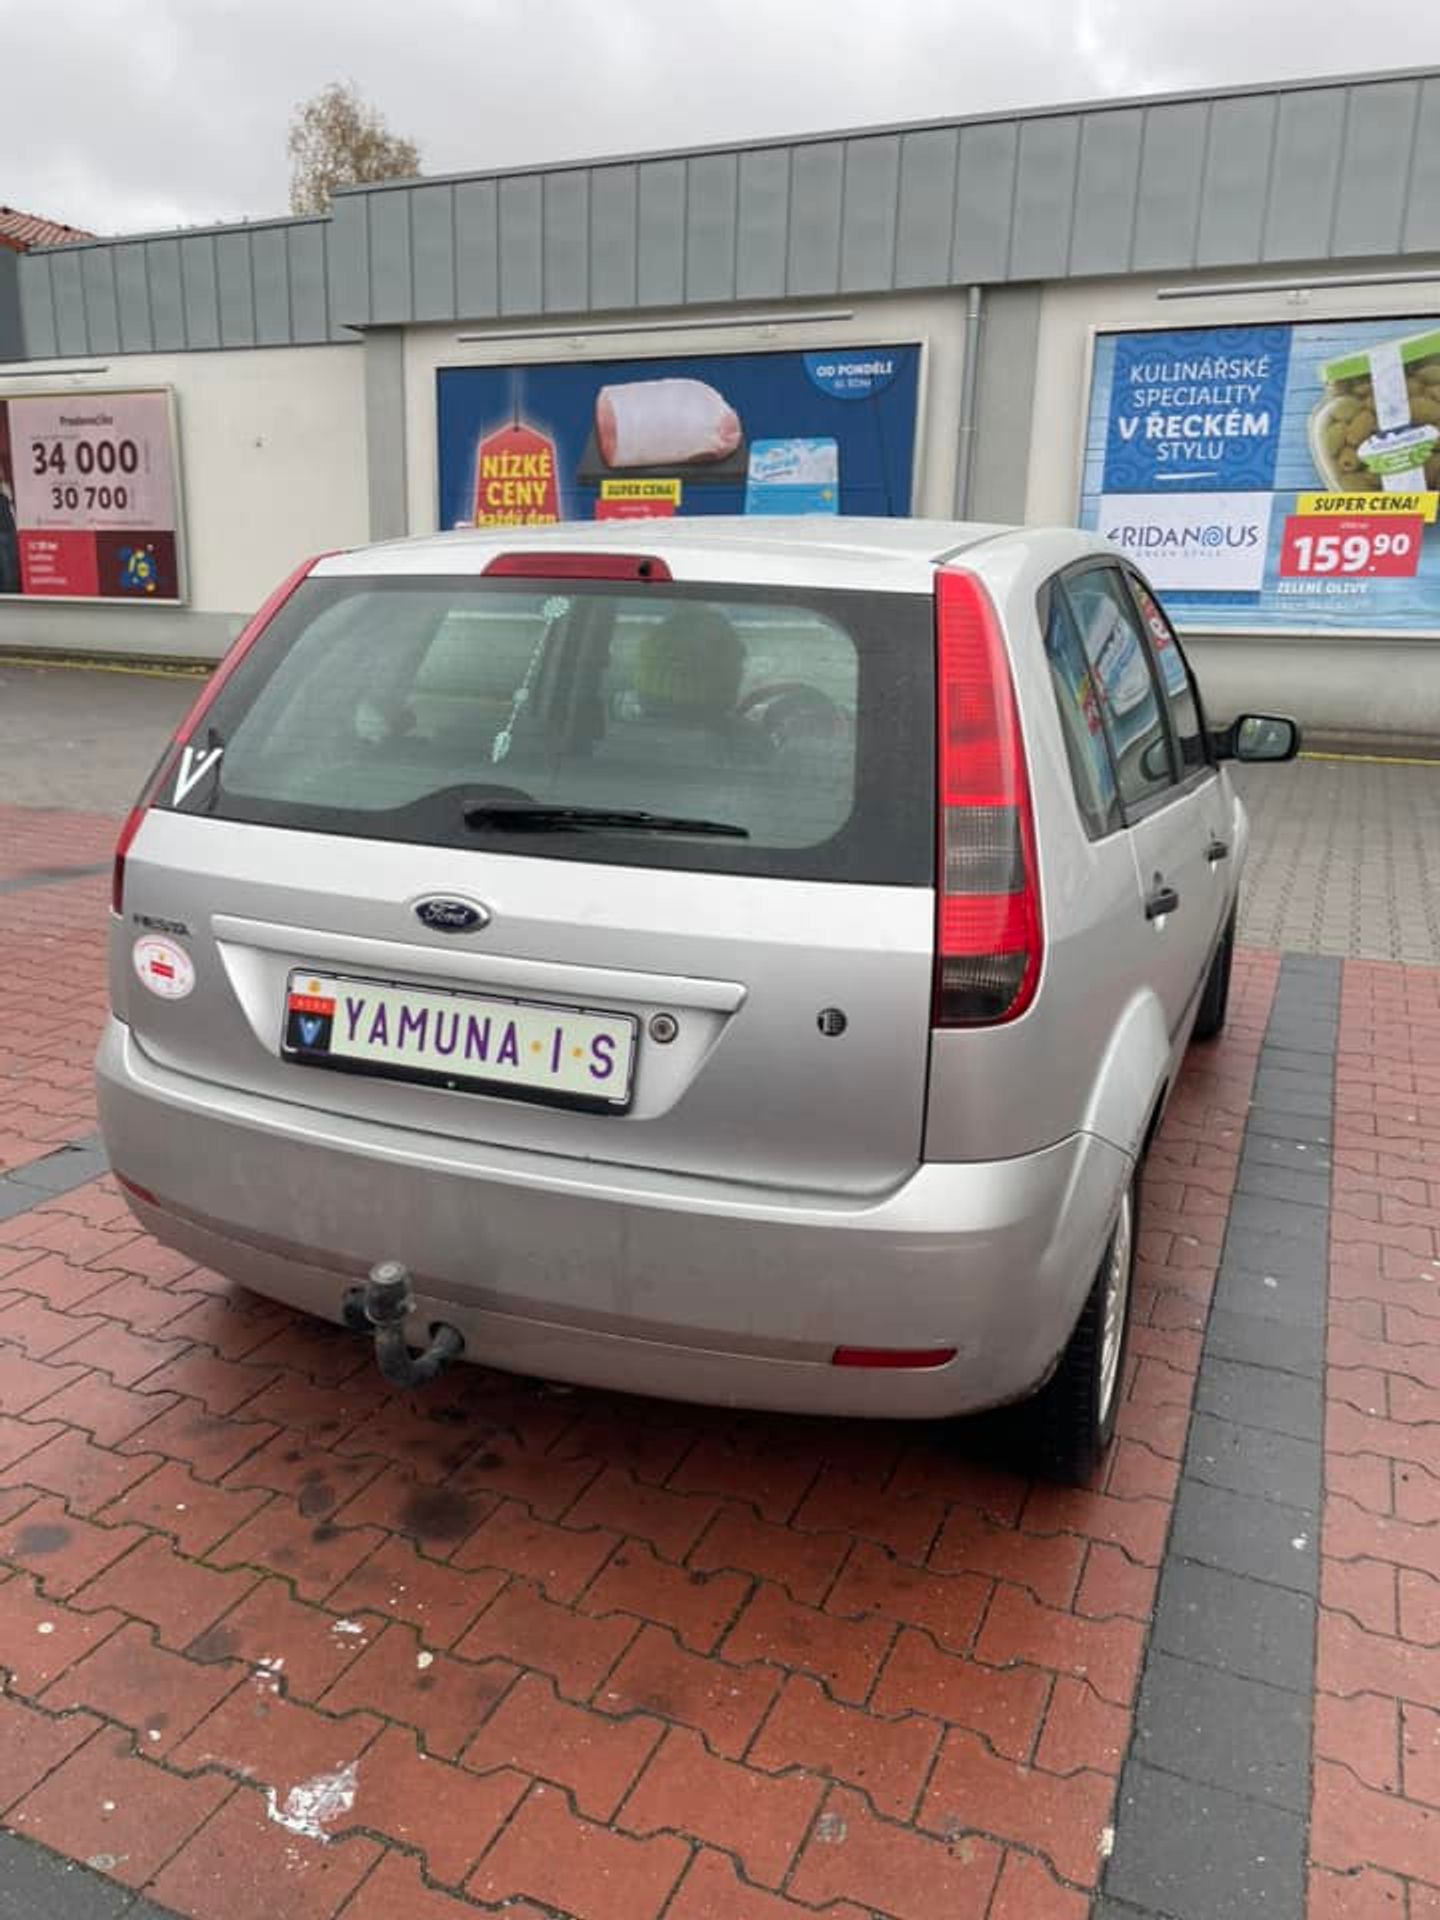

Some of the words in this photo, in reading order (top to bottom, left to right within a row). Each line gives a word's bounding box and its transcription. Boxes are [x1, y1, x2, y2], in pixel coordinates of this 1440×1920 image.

[816, 365, 835, 377] OD
[1130, 355, 1270, 384] KULINÁŘSKÉ
[1133, 385, 1262, 408] SPECIALITY
[1118, 417, 1140, 439] V
[1147, 411, 1270, 438] ŘECKÉM
[32, 442, 66, 475] 34
[76, 439, 138, 475] 000
[482, 448, 551, 478] NÍZKÉ
[1157, 441, 1223, 462] STYLU
[52, 486, 79, 510] 30
[84, 486, 127, 510] 700
[486, 479, 548, 506] CENY
[607, 483, 637, 497] SUPER
[1314, 497, 1367, 512] SUPER
[1369, 496, 1419, 511] CENA!
[526, 508, 557, 525] den
[346, 997, 519, 1066] YAMUNA
[589, 1034, 616, 1079] S
